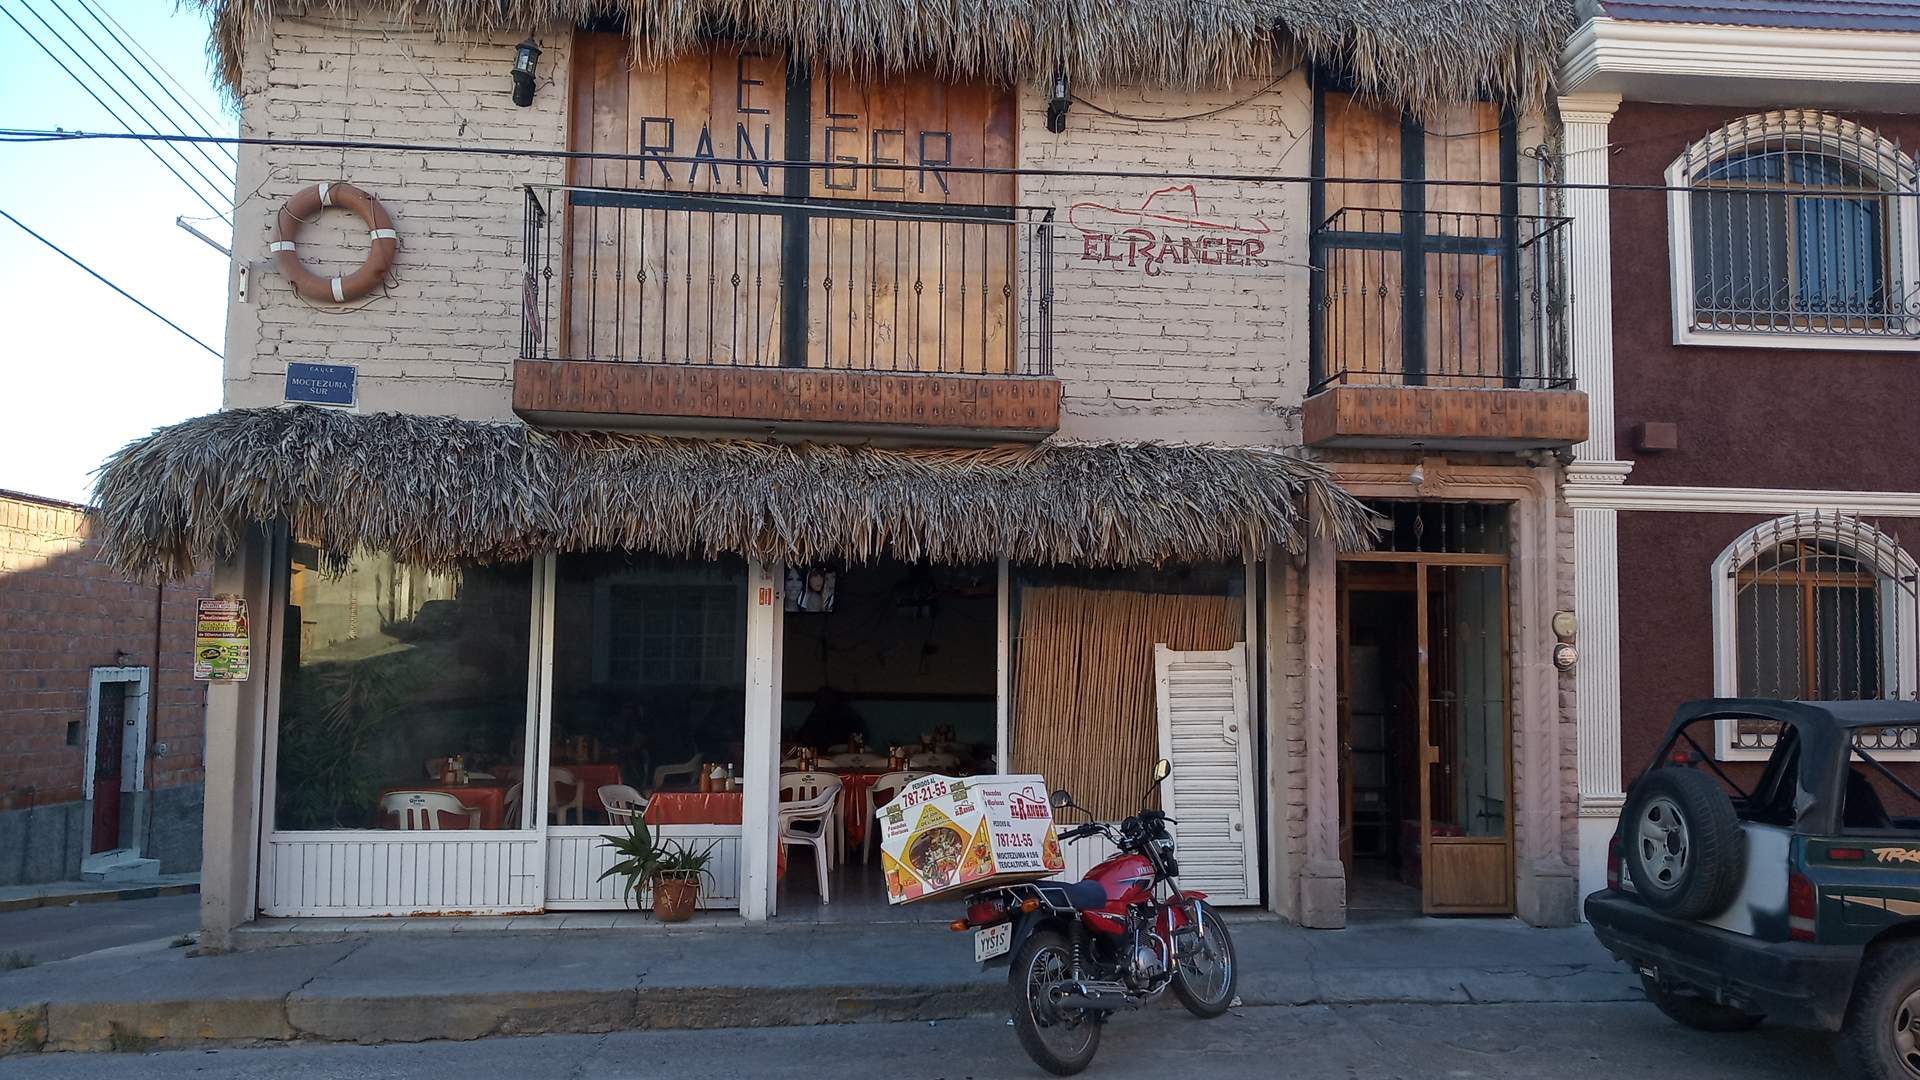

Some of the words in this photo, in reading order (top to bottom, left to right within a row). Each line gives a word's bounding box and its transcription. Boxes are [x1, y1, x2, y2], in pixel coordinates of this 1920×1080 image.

[1081, 234, 1123, 264] EL
[1123, 229, 1269, 276] RANGER
[291, 378, 348, 389] MOCTEZUMA
[309, 387, 328, 395] SUR
[912, 779, 930, 790] PEDIDOS
[902, 781, 947, 807] 787-21-55
[1010, 805, 1018, 817] EL
[1017, 798, 1049, 820] RANGER
[923, 811, 938, 819] MEJOR
[887, 822, 907, 831] Pescados
[891, 828, 909, 836] Mariscos
[995, 833, 1033, 847] 787-21-55
[996, 851, 1027, 860] MOCTEZUMA
[998, 860, 1032, 869] TEOCALTICHE,
